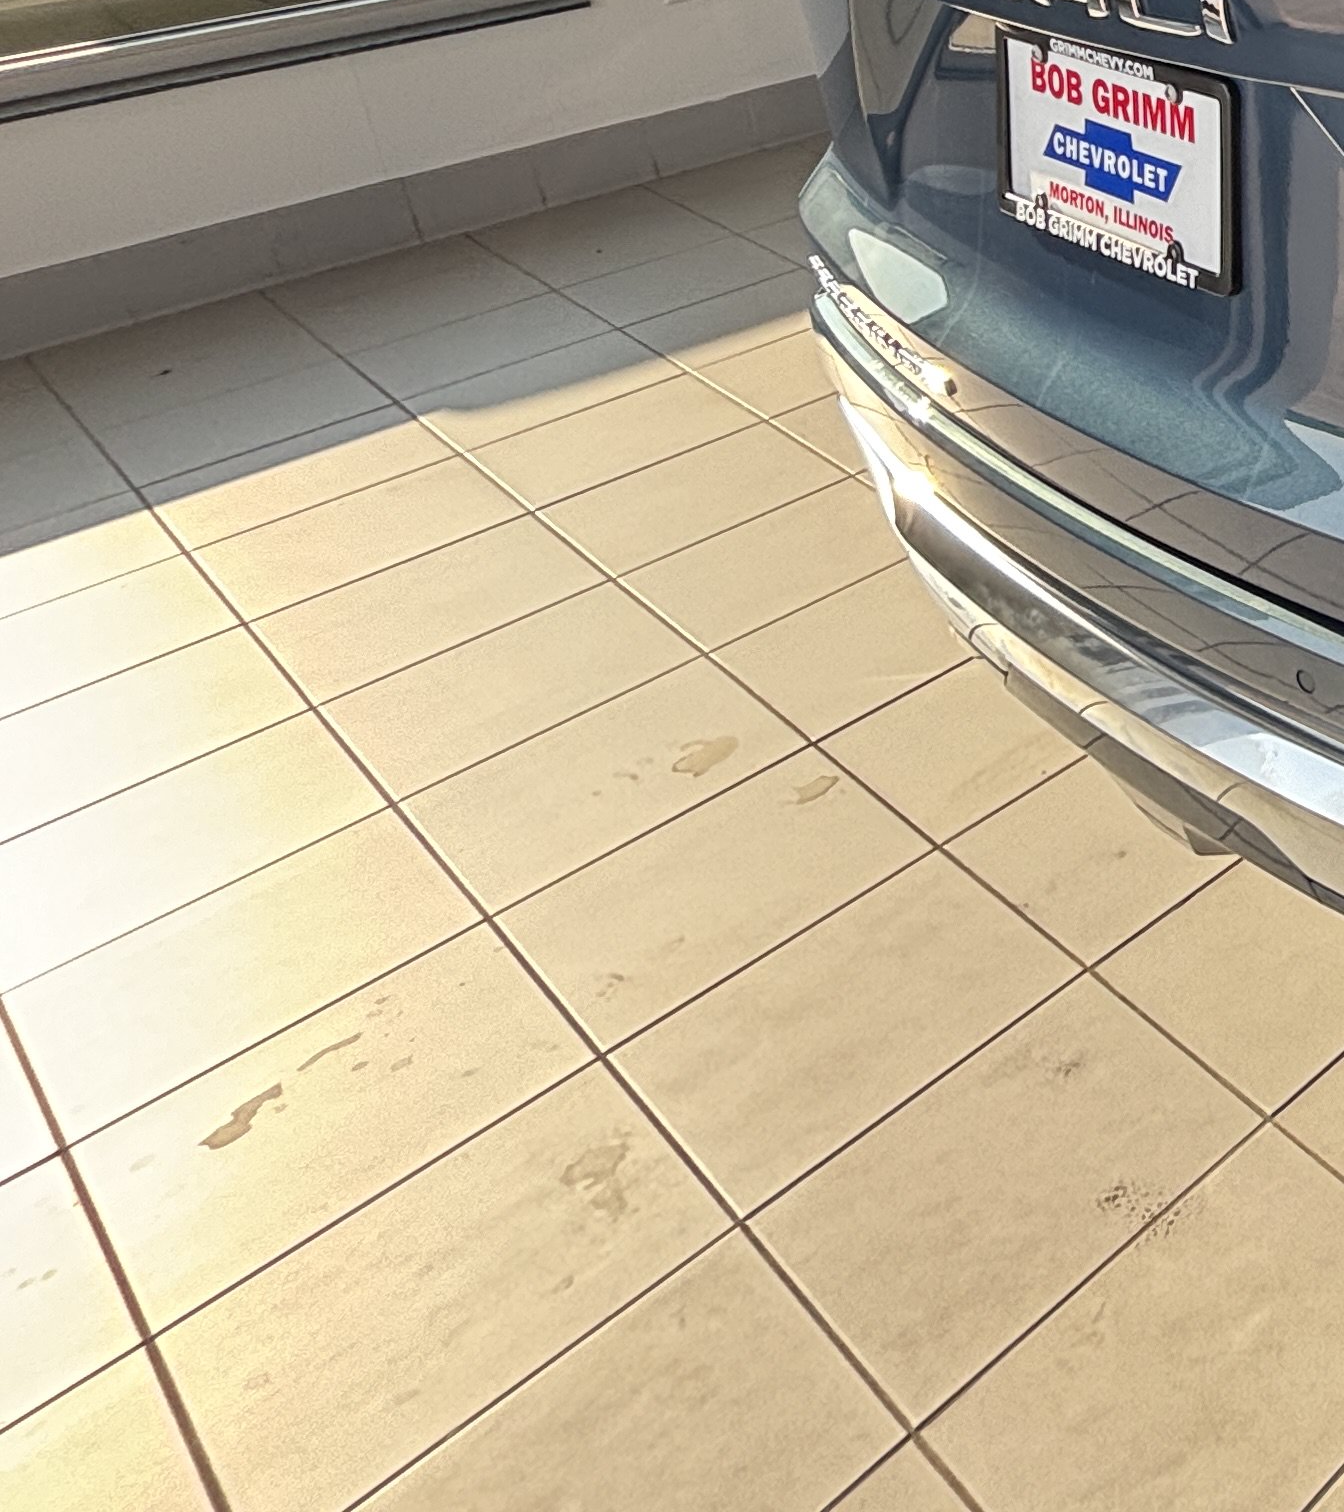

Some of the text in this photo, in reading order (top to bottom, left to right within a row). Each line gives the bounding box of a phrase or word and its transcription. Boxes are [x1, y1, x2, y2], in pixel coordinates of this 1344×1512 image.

[1050, 38, 1154, 80] GRIMMCHEVY.COM
[1031, 58, 1195, 144] BOB GRIMM
[1052, 131, 1169, 192] CHEVROLET
[1049, 180, 1175, 244] MORTON, ILLINOIS
[1015, 200, 1200, 289] BOB GRIMM CHEVROLET
